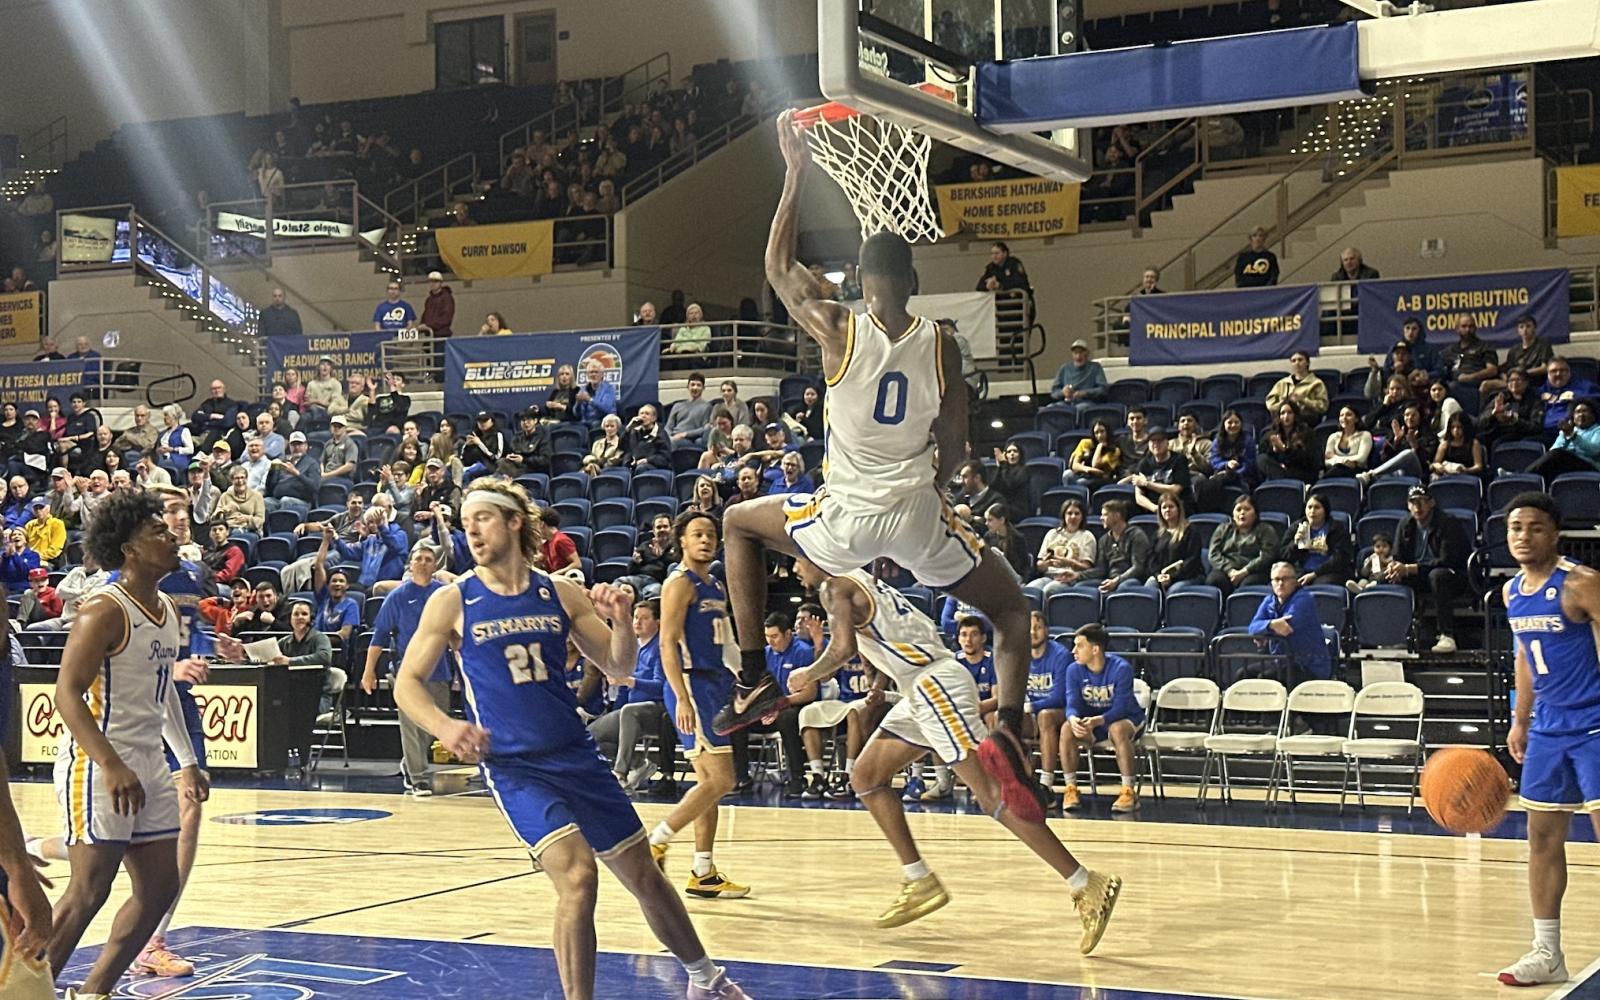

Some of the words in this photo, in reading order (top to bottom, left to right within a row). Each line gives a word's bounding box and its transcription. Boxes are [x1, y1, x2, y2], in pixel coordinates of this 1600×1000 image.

[950, 185, 1007, 200] BERKSHIRE
[1010, 182, 1064, 197] HATHAWAY
[963, 205, 994, 217] HOME
[997, 201, 1046, 216] SERVICES
[1013, 218, 1063, 233] REALTORS
[461, 244, 489, 258] CURRY
[491, 242, 527, 256] DAWSON
[1396, 294, 1422, 312] A-B
[1426, 287, 1529, 311] DISTRIBUTING
[400, 330, 416, 340] 103
[1146, 321, 1216, 340] PRINCIPAL
[1220, 314, 1302, 337] INDUSTRIES
[308, 337, 350, 351] LEGRAND
[344, 352, 376, 366] RANCH
[14, 374, 44, 388] TERESA
[47, 372, 82, 386] GILBERT
[19, 390, 48, 402] FAMILY
[873, 371, 908, 425] 0
[148, 640, 177, 660] Rams
[1530, 639, 1549, 675] 1
[504, 642, 549, 685] 21
[157, 665, 169, 703] 11
